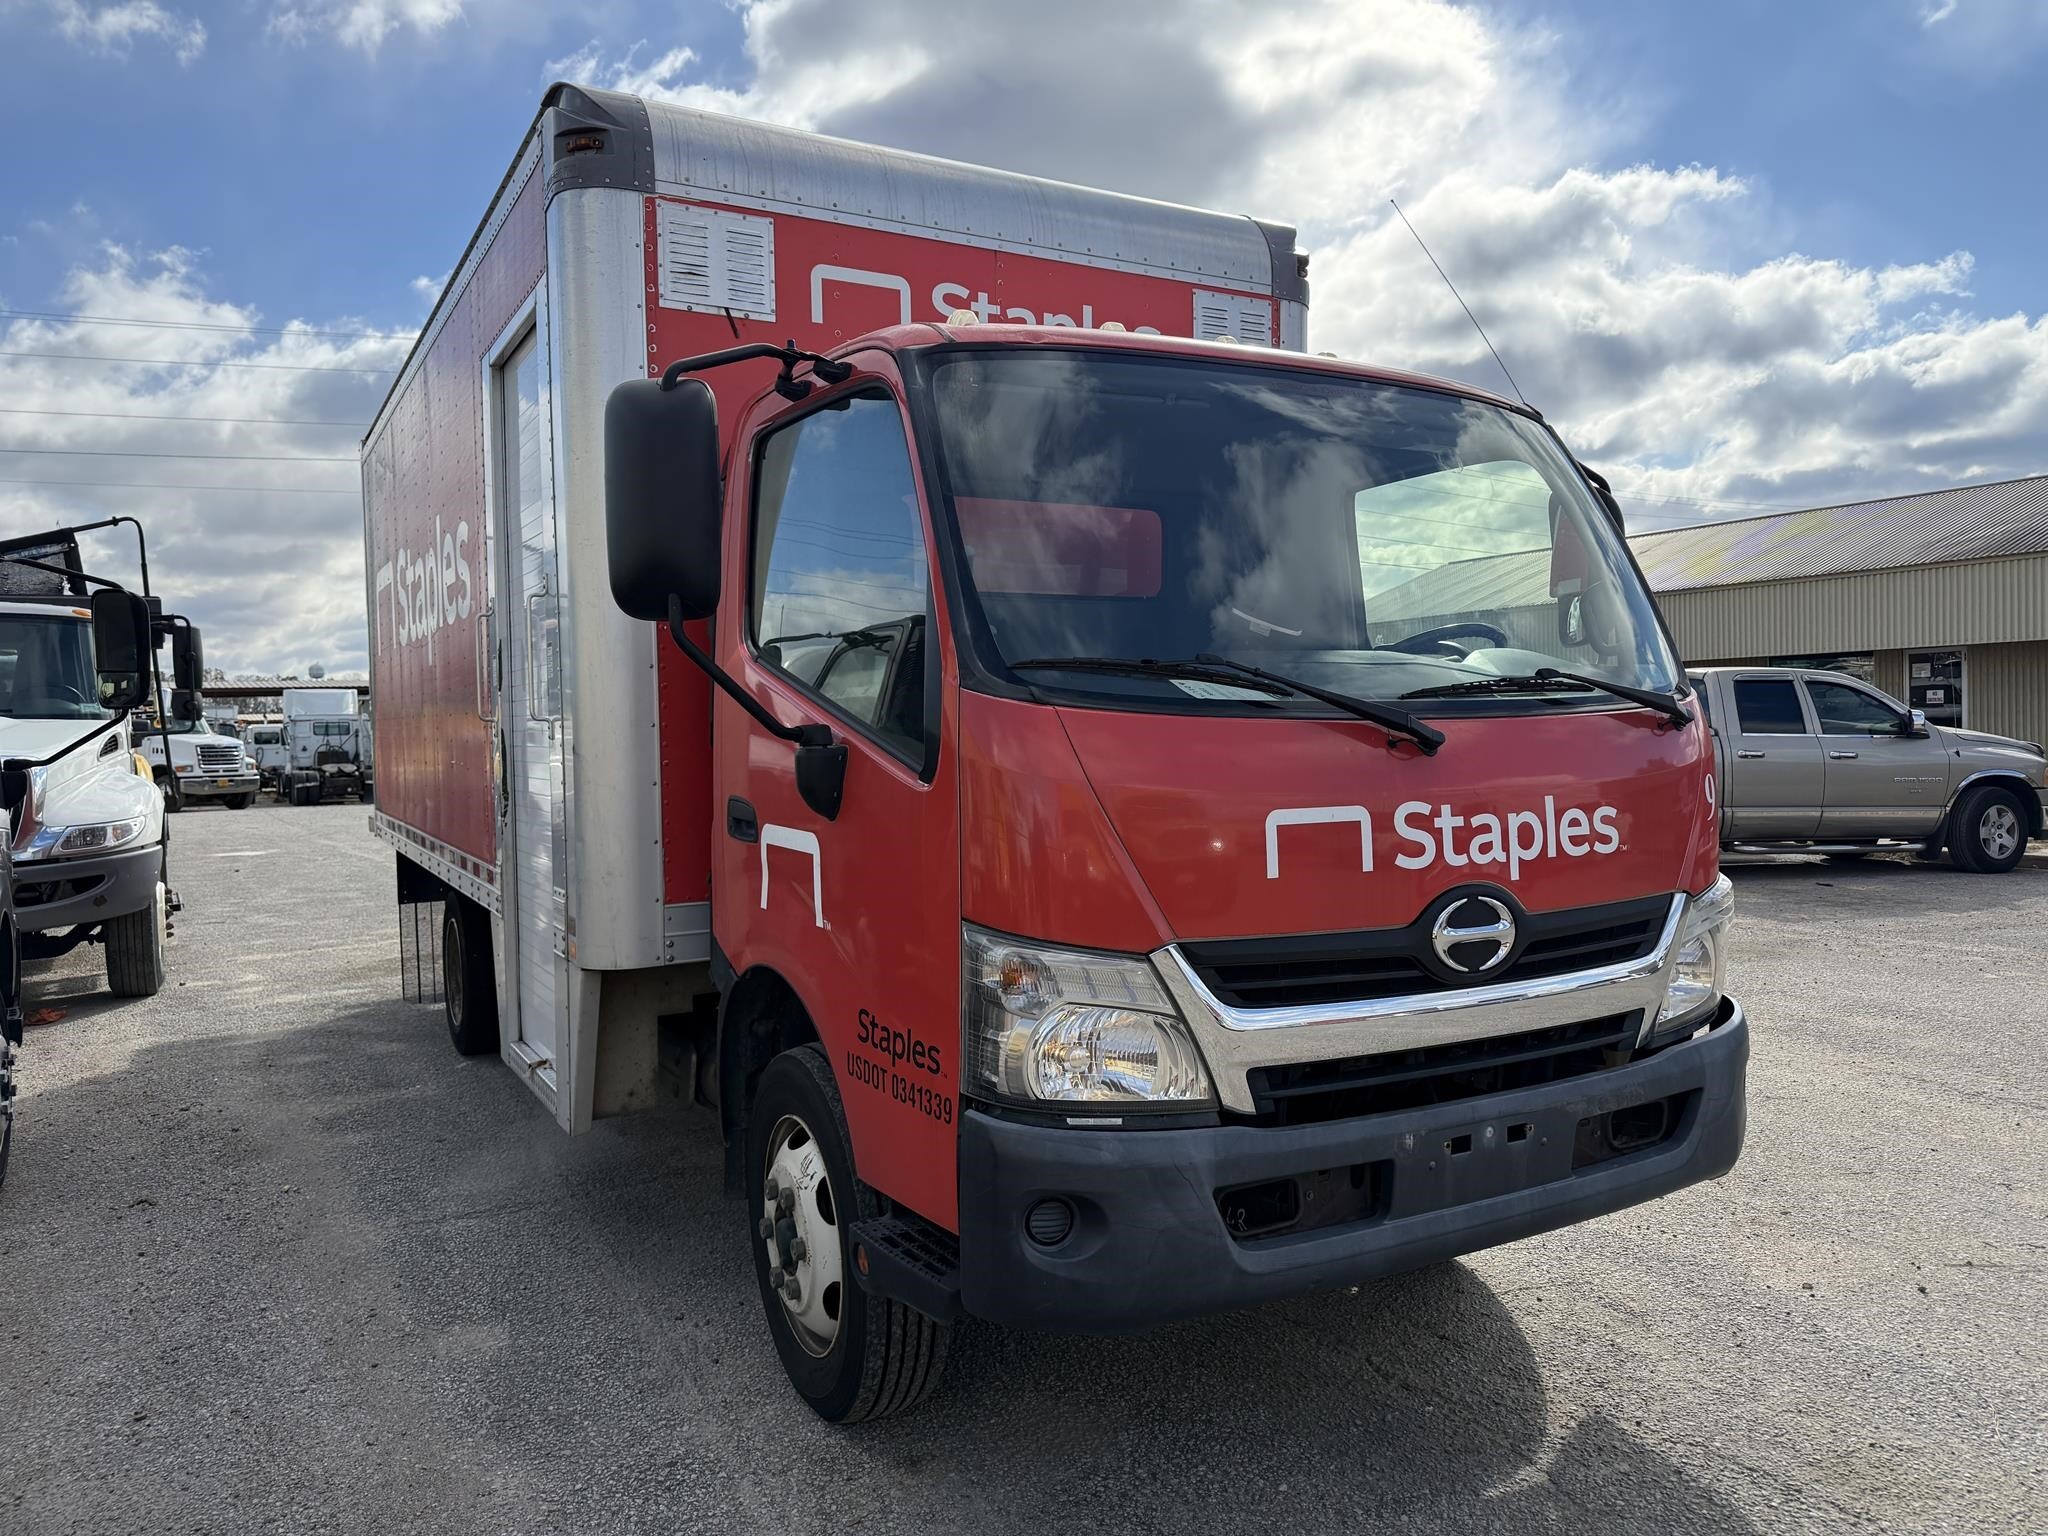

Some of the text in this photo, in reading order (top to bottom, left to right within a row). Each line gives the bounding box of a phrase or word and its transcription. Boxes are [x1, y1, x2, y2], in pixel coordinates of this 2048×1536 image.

[397, 514, 471, 666] Staples
[1704, 773, 1716, 821] 9
[1393, 795, 1620, 881] Staples
[857, 1008, 941, 1075] Staples
[847, 1050, 952, 1125] USDOT 0341339
